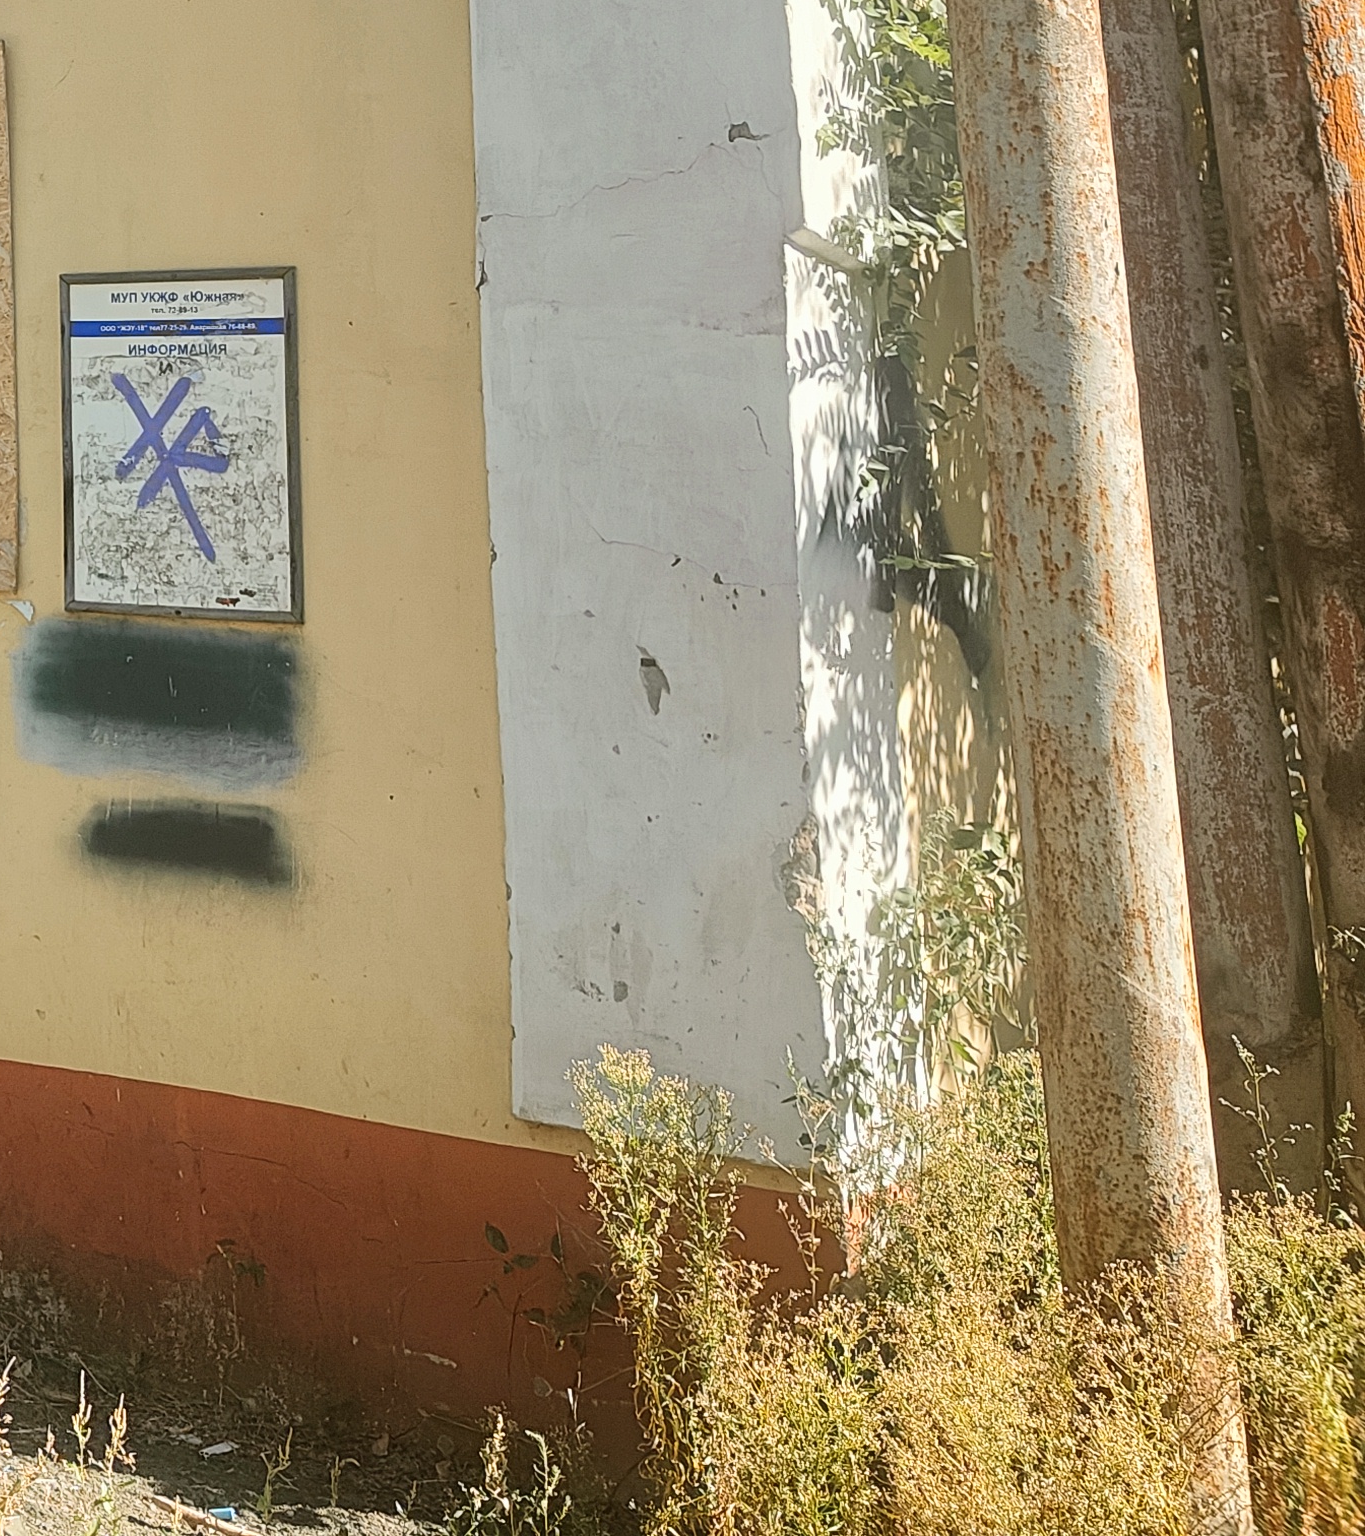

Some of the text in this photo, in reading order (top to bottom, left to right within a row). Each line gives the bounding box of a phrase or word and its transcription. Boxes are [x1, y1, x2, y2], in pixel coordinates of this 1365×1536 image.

[110, 292, 138, 304] МУП
[141, 292, 179, 304] УКЖФ
[128, 343, 228, 357] ИНФОРМАЦИЯ
